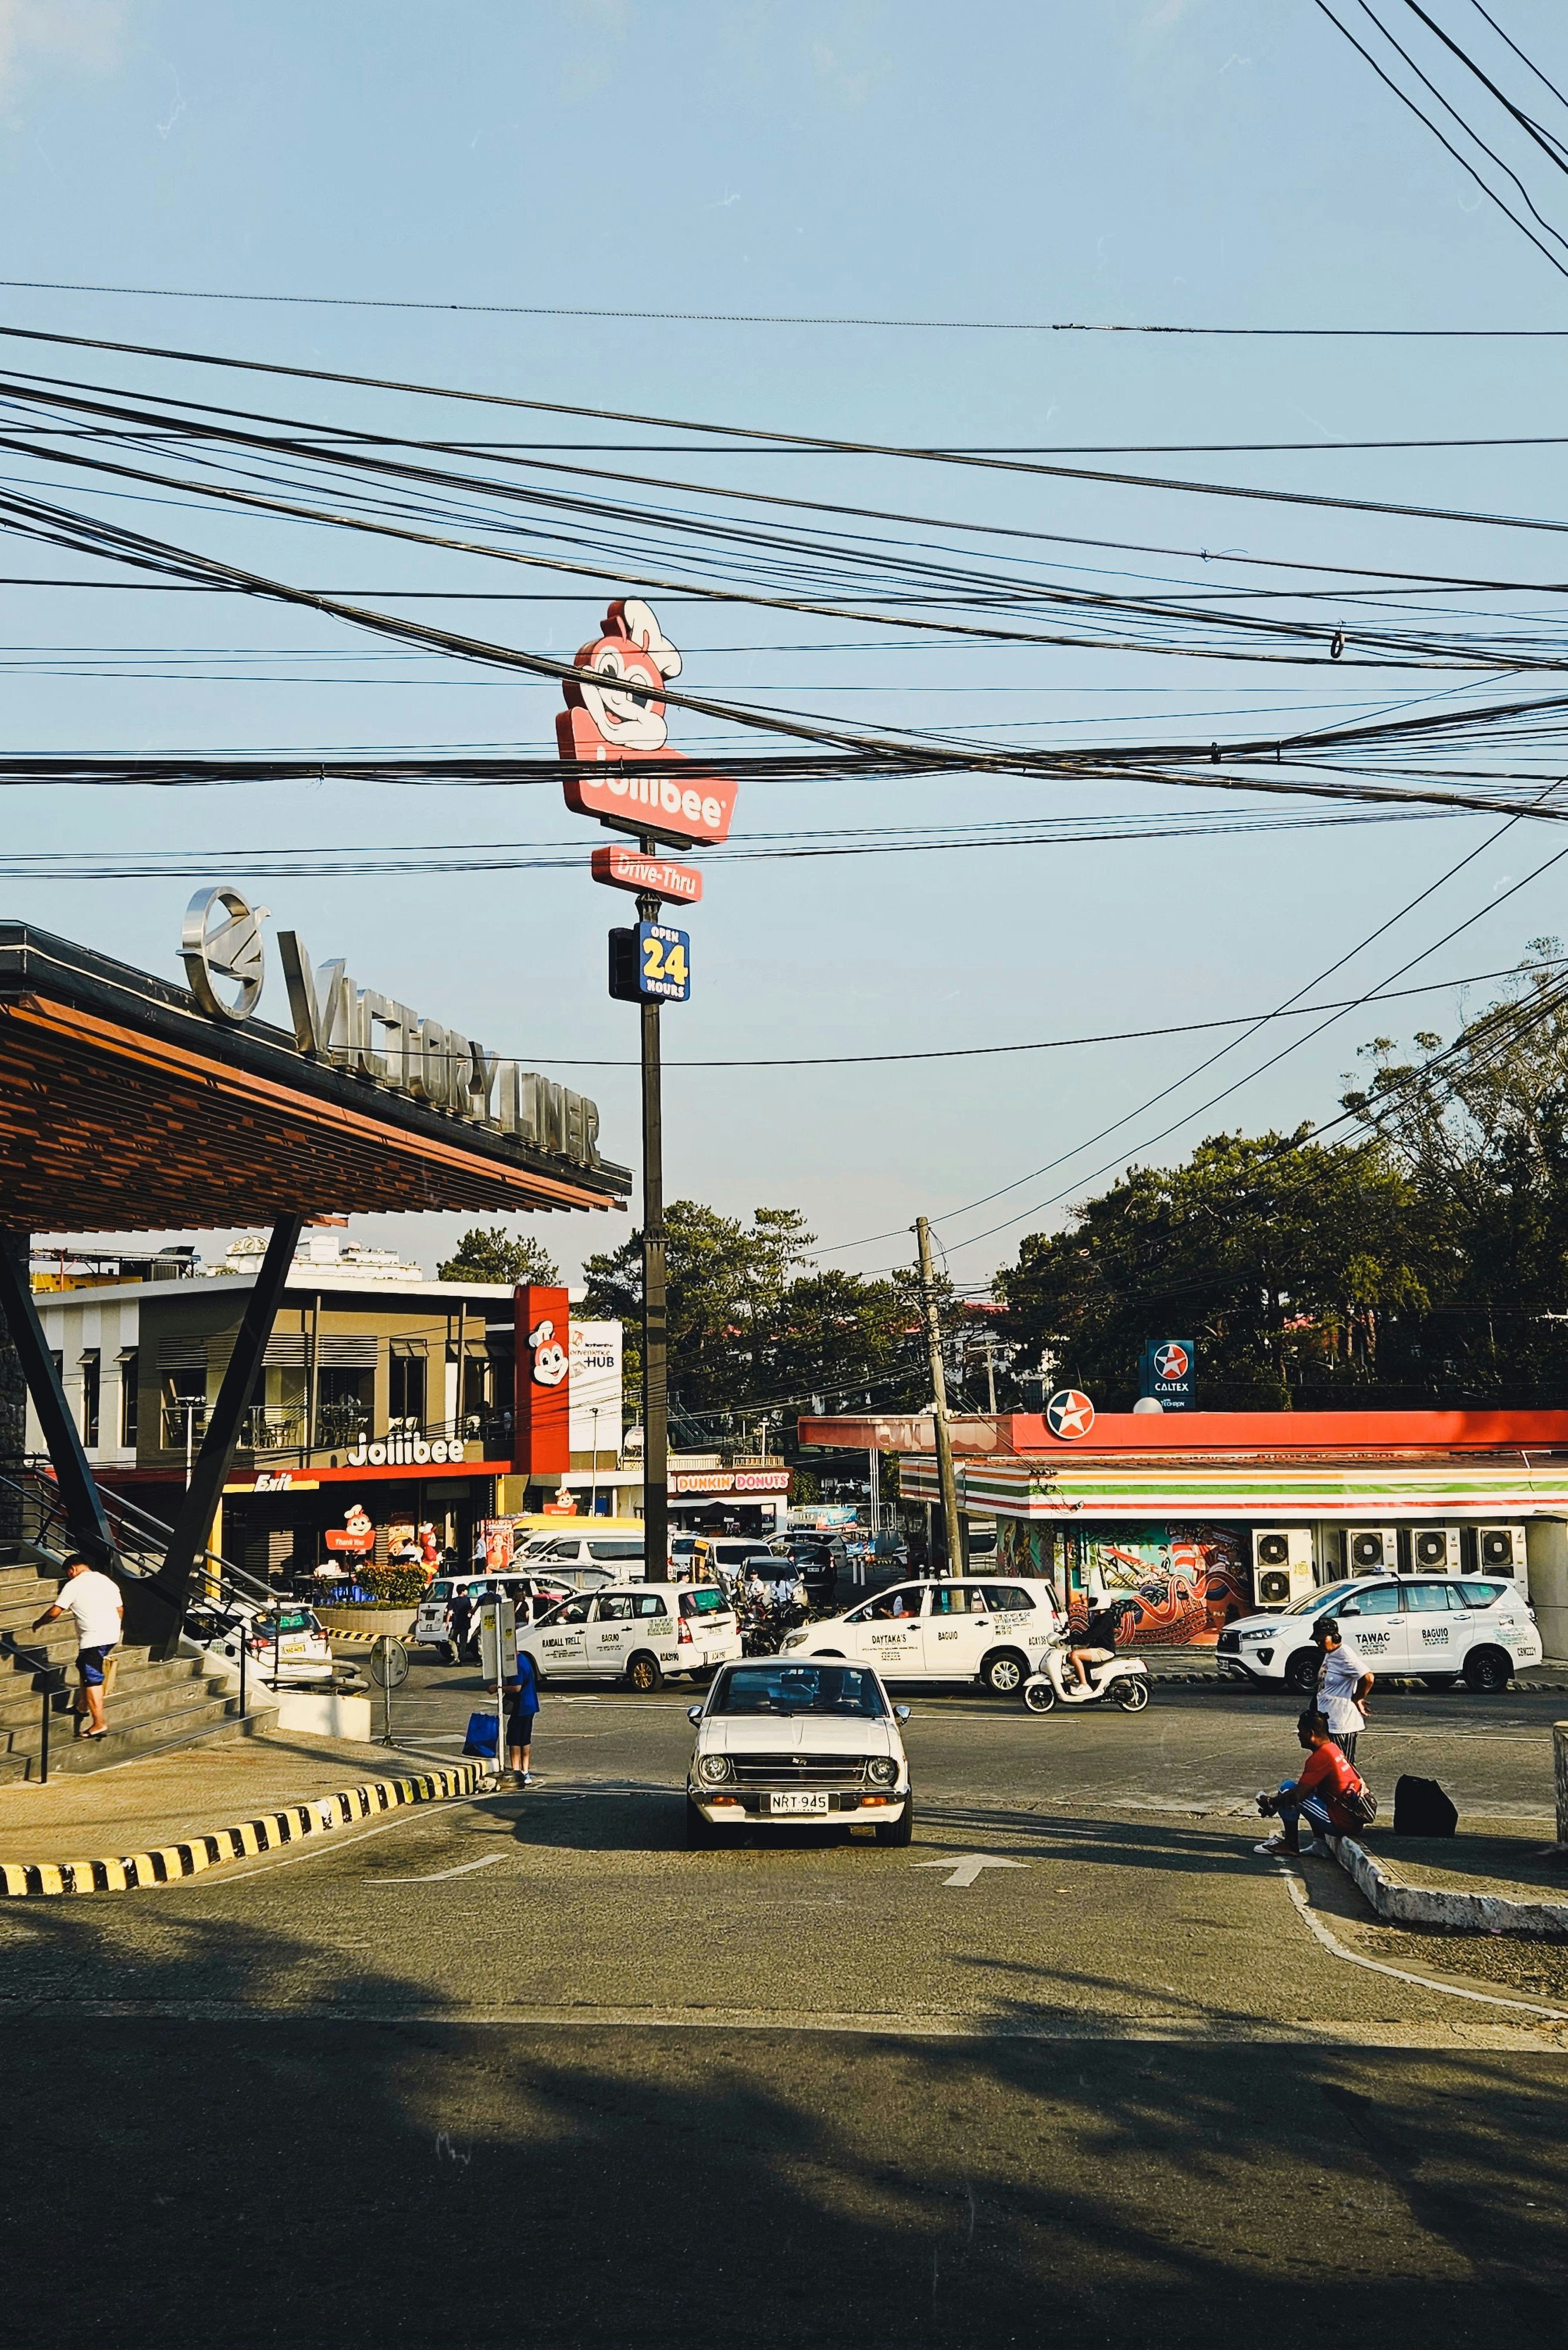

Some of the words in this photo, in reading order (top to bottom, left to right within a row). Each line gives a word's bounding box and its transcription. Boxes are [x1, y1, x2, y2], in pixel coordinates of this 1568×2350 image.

[617, 853, 696, 894] Drive-Thru
[650, 926, 679, 943] OPEN
[643, 938, 689, 985] 24
[647, 979, 684, 998] HOURS
[585, 1356, 615, 1367] HUB
[1154, 1383, 1189, 1392] CALTEX
[347, 1432, 465, 1467] Jollibee
[254, 1473, 293, 1492] Exit
[679, 1475, 734, 1491] DUNKIN'
[736, 1474, 788, 1489] DONUTS
[872, 1634, 906, 1644] DAYTAKA'S
[938, 1631, 958, 1641] BAGUIO
[1355, 1632, 1391, 1644] TAWAC
[1422, 1627, 1449, 1639] BAGUIO
